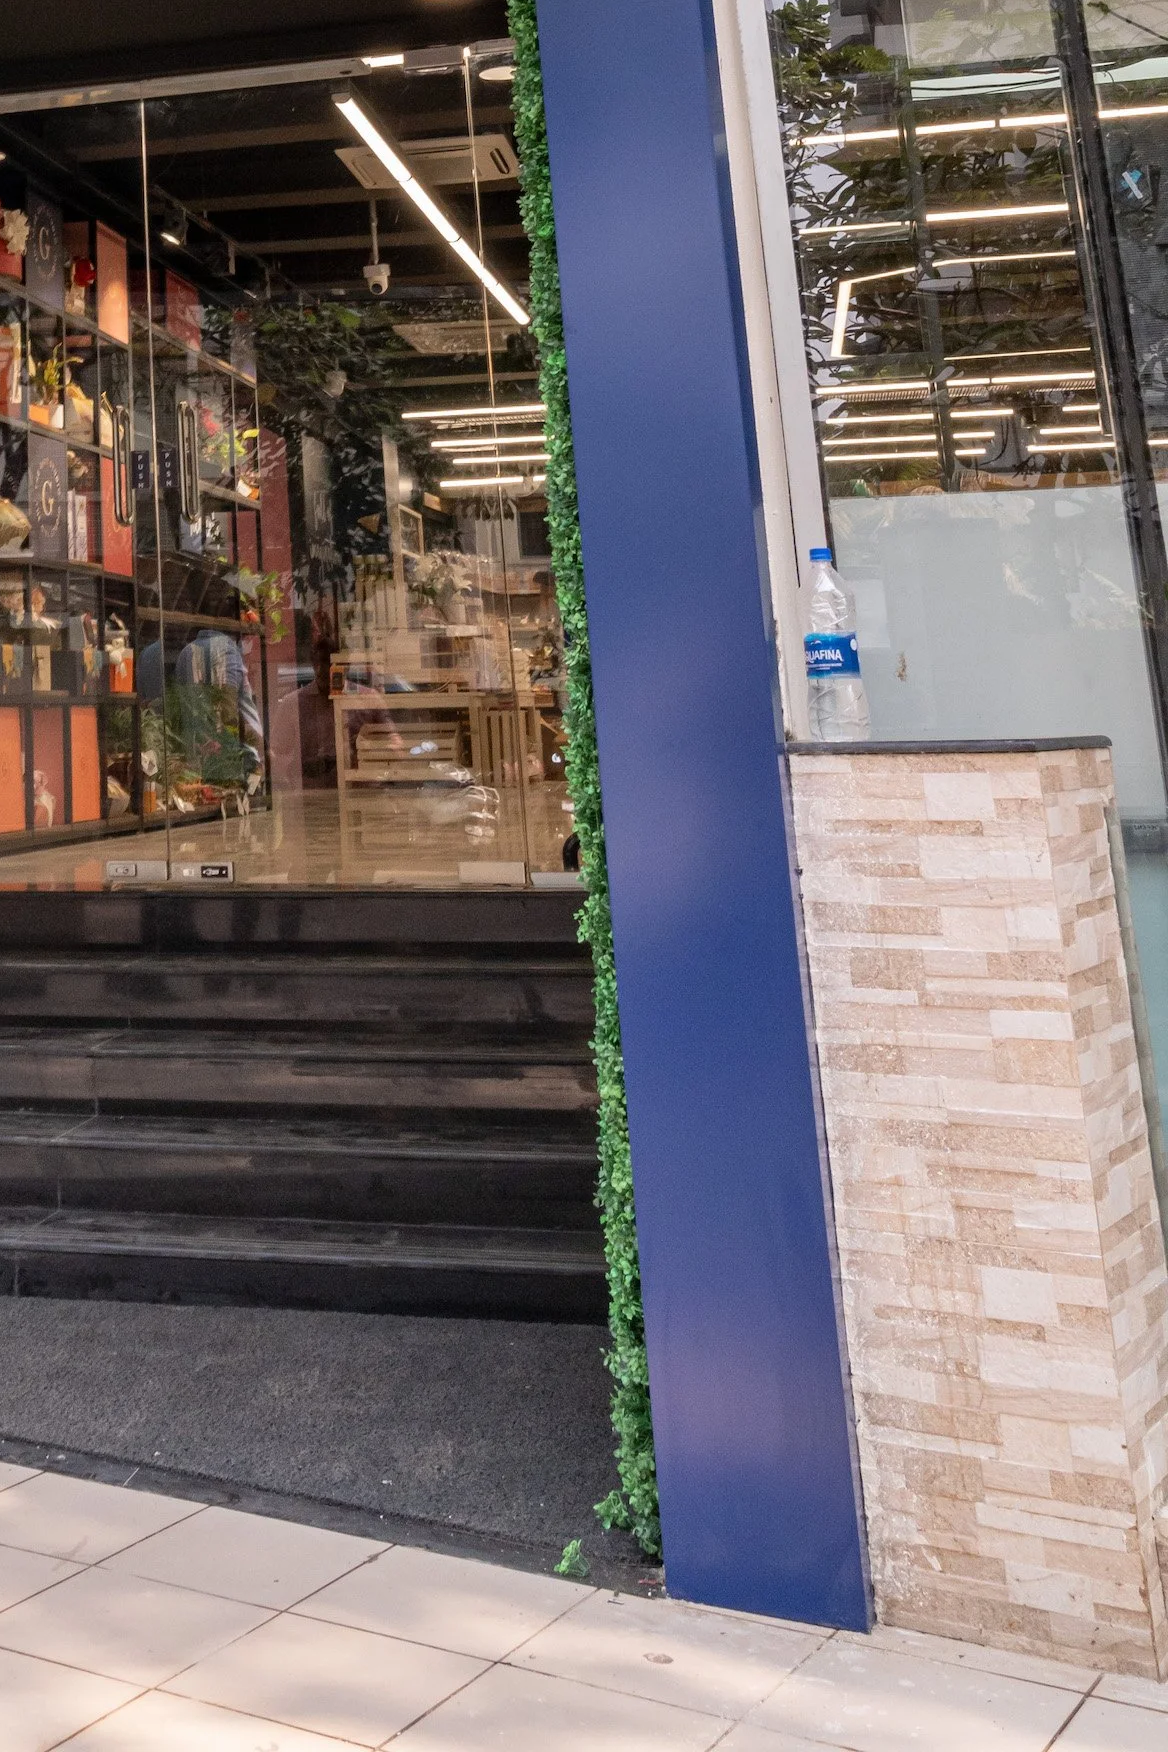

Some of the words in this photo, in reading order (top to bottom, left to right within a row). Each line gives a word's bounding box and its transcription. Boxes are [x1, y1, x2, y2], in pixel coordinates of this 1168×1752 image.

[137, 454, 145, 489] PUSH
[164, 452, 172, 487] PUSH
[41, 480, 55, 517] G
